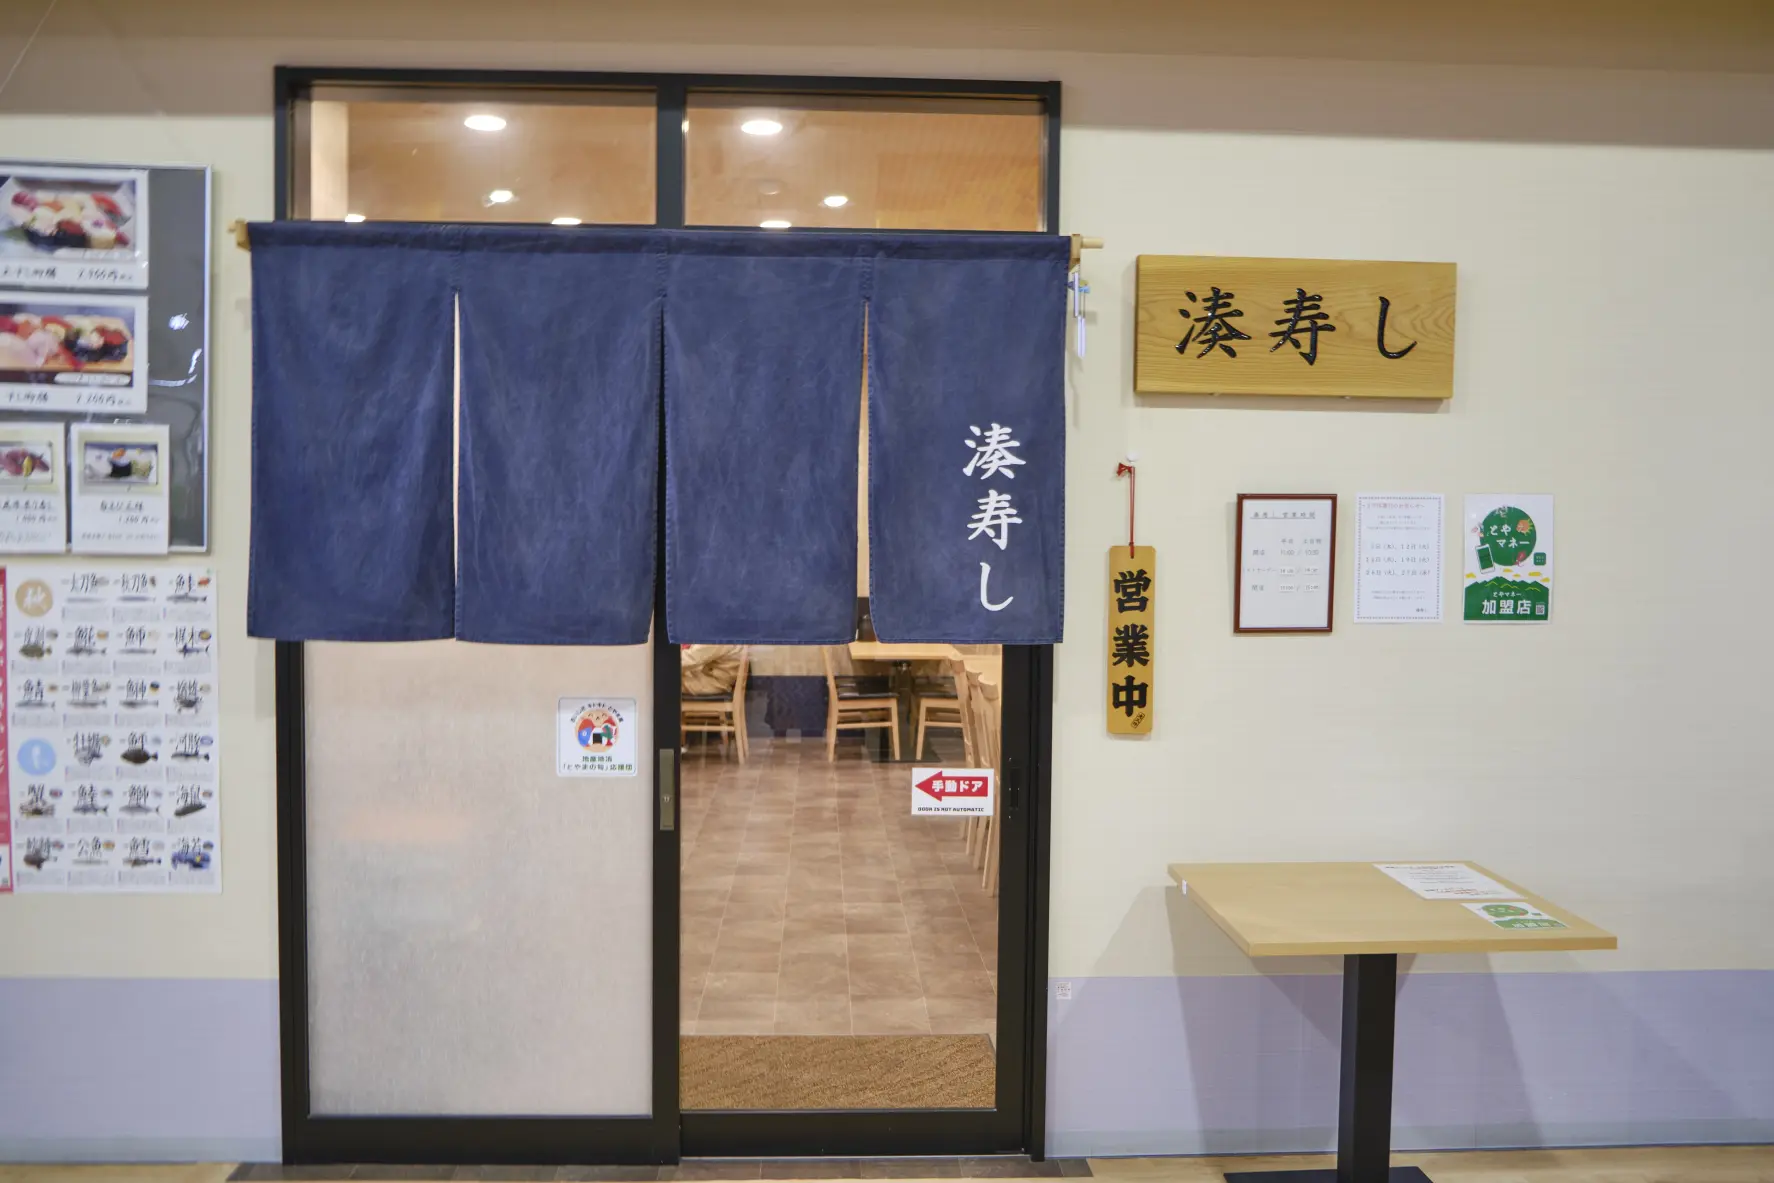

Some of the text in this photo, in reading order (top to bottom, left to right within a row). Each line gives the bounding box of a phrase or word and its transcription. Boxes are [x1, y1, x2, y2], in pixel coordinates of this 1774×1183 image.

[1175, 286, 1418, 366] 湊寿し
[962, 423, 1027, 612] 湊寿し
[1496, 537, 1531, 549] マネー
[1481, 599, 1532, 615] 加盟店
[1111, 568, 1151, 718] 営業中
[931, 779, 983, 793] 手動ドア
